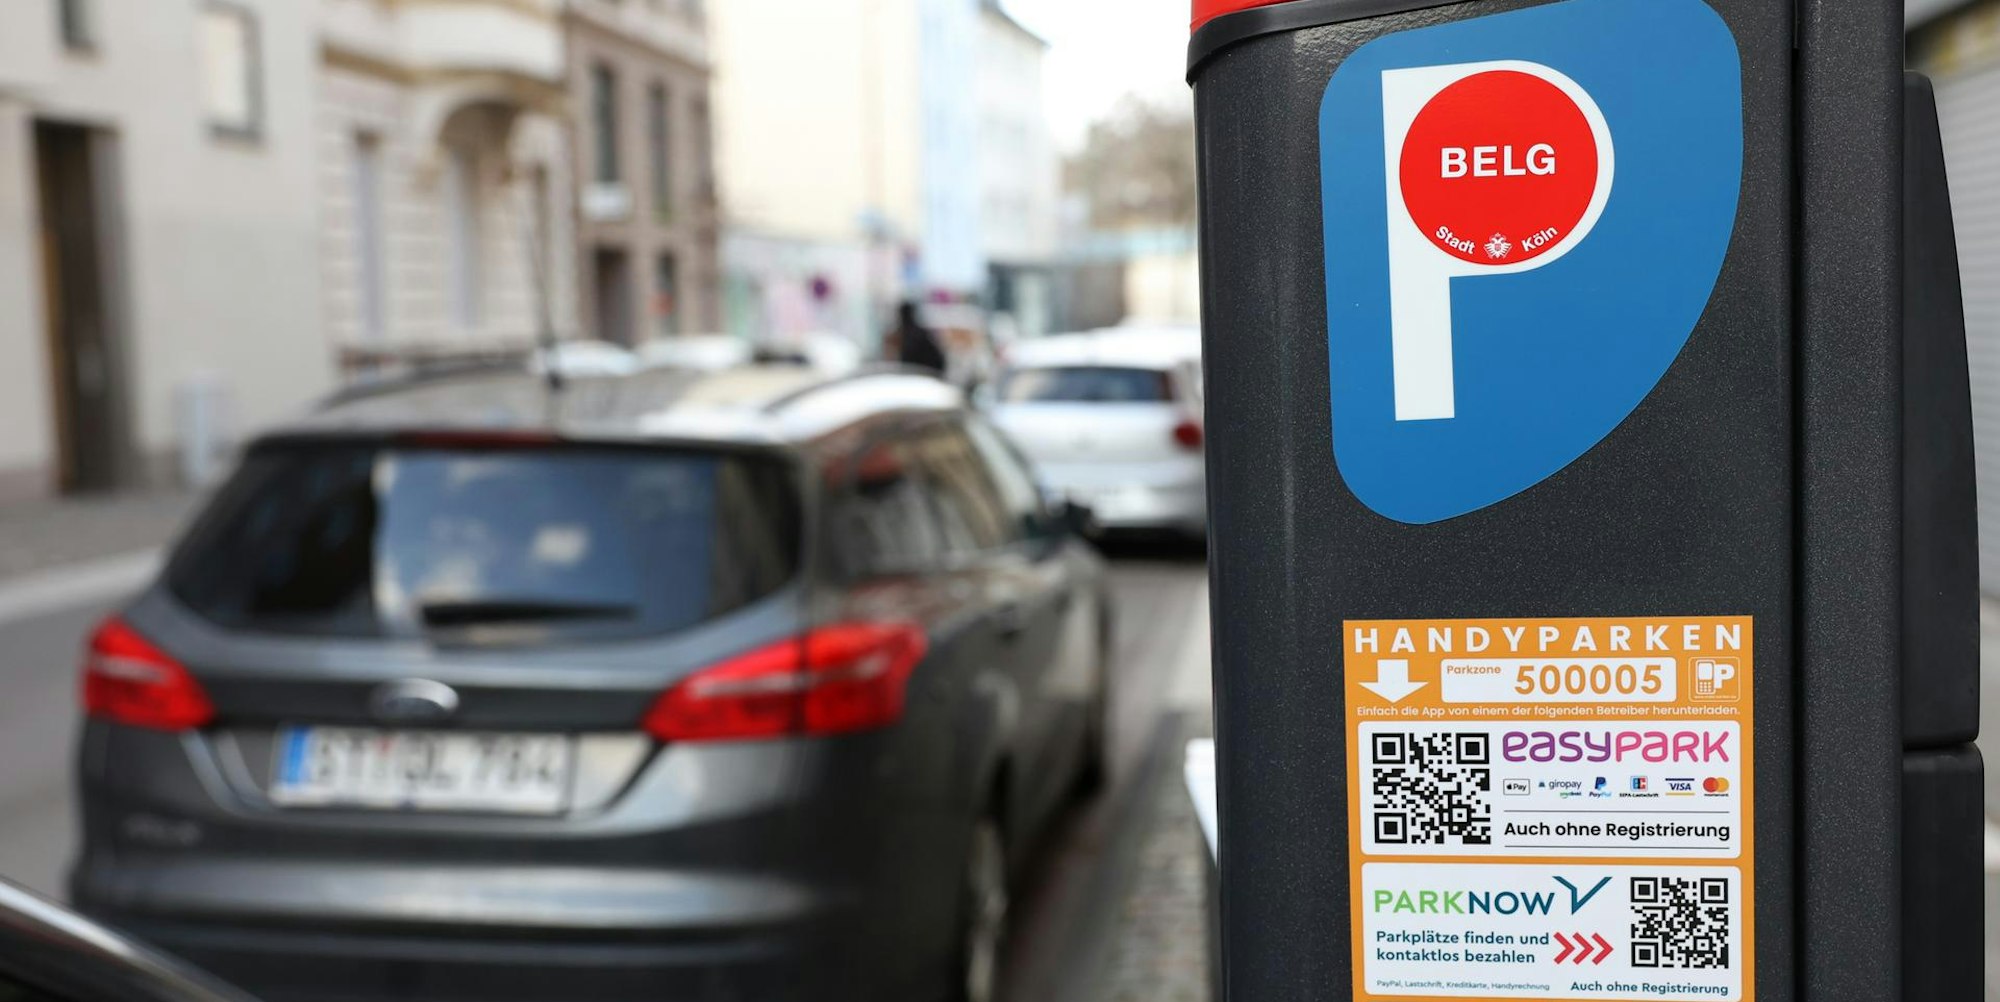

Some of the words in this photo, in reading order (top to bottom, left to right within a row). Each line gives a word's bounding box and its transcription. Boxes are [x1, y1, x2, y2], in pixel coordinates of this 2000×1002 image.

[1440, 143, 1556, 178] BELG
[1435, 225, 1476, 255] Stadt
[1521, 225, 1559, 252] Köln
[1354, 624, 1742, 653] HANDYPARKEN
[1446, 664, 1502, 675] Parkzone
[1514, 664, 1662, 695] 500005
[1357, 706, 1398, 716] Einfach
[1401, 706, 1419, 716] die
[1422, 706, 1445, 718] App
[1449, 707, 1469, 716] von
[1472, 706, 1509, 716] einem
[1511, 705, 1531, 716] der
[1534, 705, 1593, 718] folgenden
[1596, 705, 1650, 716] Betreiber
[1653, 705, 1741, 716] herunterladen.
[1513, 783, 1527, 791] Pay
[1548, 779, 1582, 790] giropay
[1669, 782, 1692, 791] VISA
[1504, 822, 1550, 836] Auch
[1555, 822, 1601, 837] ohne
[1606, 822, 1730, 841] Registrierung
[1376, 930, 1459, 946] Parkplätze
[1464, 930, 1514, 945] finden
[1519, 931, 1549, 945] und
[1376, 948, 1459, 962] kontaktlos
[1464, 949, 1535, 963] bezahlen
[1376, 980, 1403, 988] PayPal,
[1404, 980, 1445, 989] Lastschrift,
[1446, 981, 1490, 990] Kreditkarte,
[1491, 982, 1550, 991] Handyrechnung
[1570, 981, 1602, 992] Auch
[1606, 981, 1638, 992] ohne
[1642, 982, 1729, 997] Registrierung
